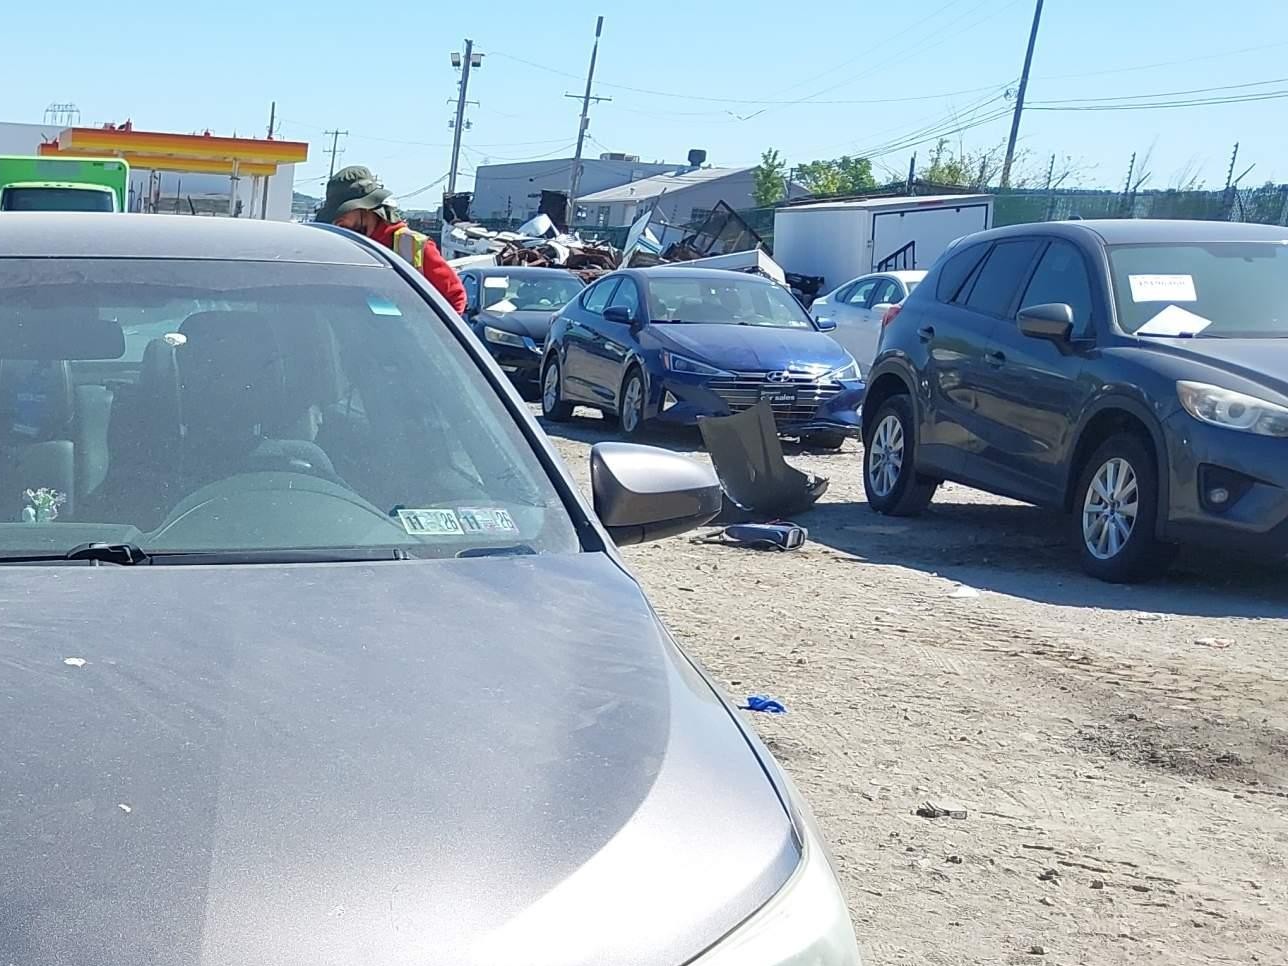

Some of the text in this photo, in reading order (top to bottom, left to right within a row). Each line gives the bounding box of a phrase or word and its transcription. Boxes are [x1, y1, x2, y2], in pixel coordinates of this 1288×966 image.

[406, 512, 458, 530] 11 26
[462, 511, 514, 530] 11 26
